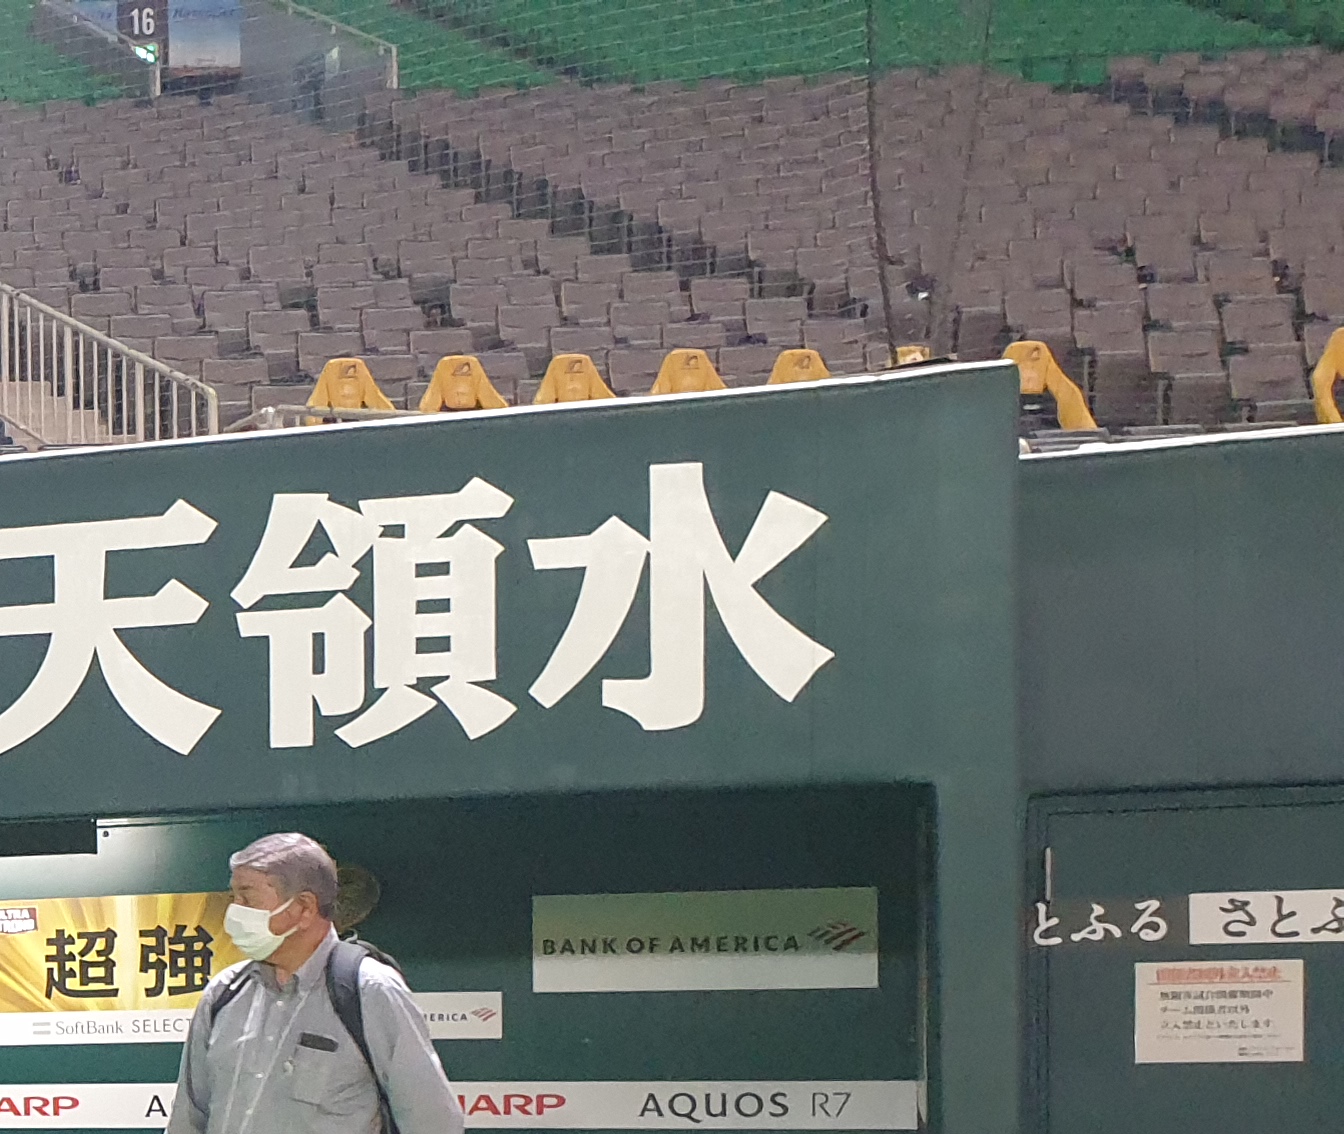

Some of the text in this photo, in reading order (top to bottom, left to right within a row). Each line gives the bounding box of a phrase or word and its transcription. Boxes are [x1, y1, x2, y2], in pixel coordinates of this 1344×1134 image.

[131, 8, 154, 35] 16
[1034, 899, 1168, 945] とふる
[1219, 895, 1344, 937] さとふ
[542, 935, 801, 956] BANK OF AMERICA
[55, 1018, 192, 1035] SoftBank SELECT
[424, 1013, 468, 1022] ERICA
[457, 1094, 567, 1116] ARP
[638, 1091, 790, 1123] AQUOS
[811, 1091, 852, 1118] R7
